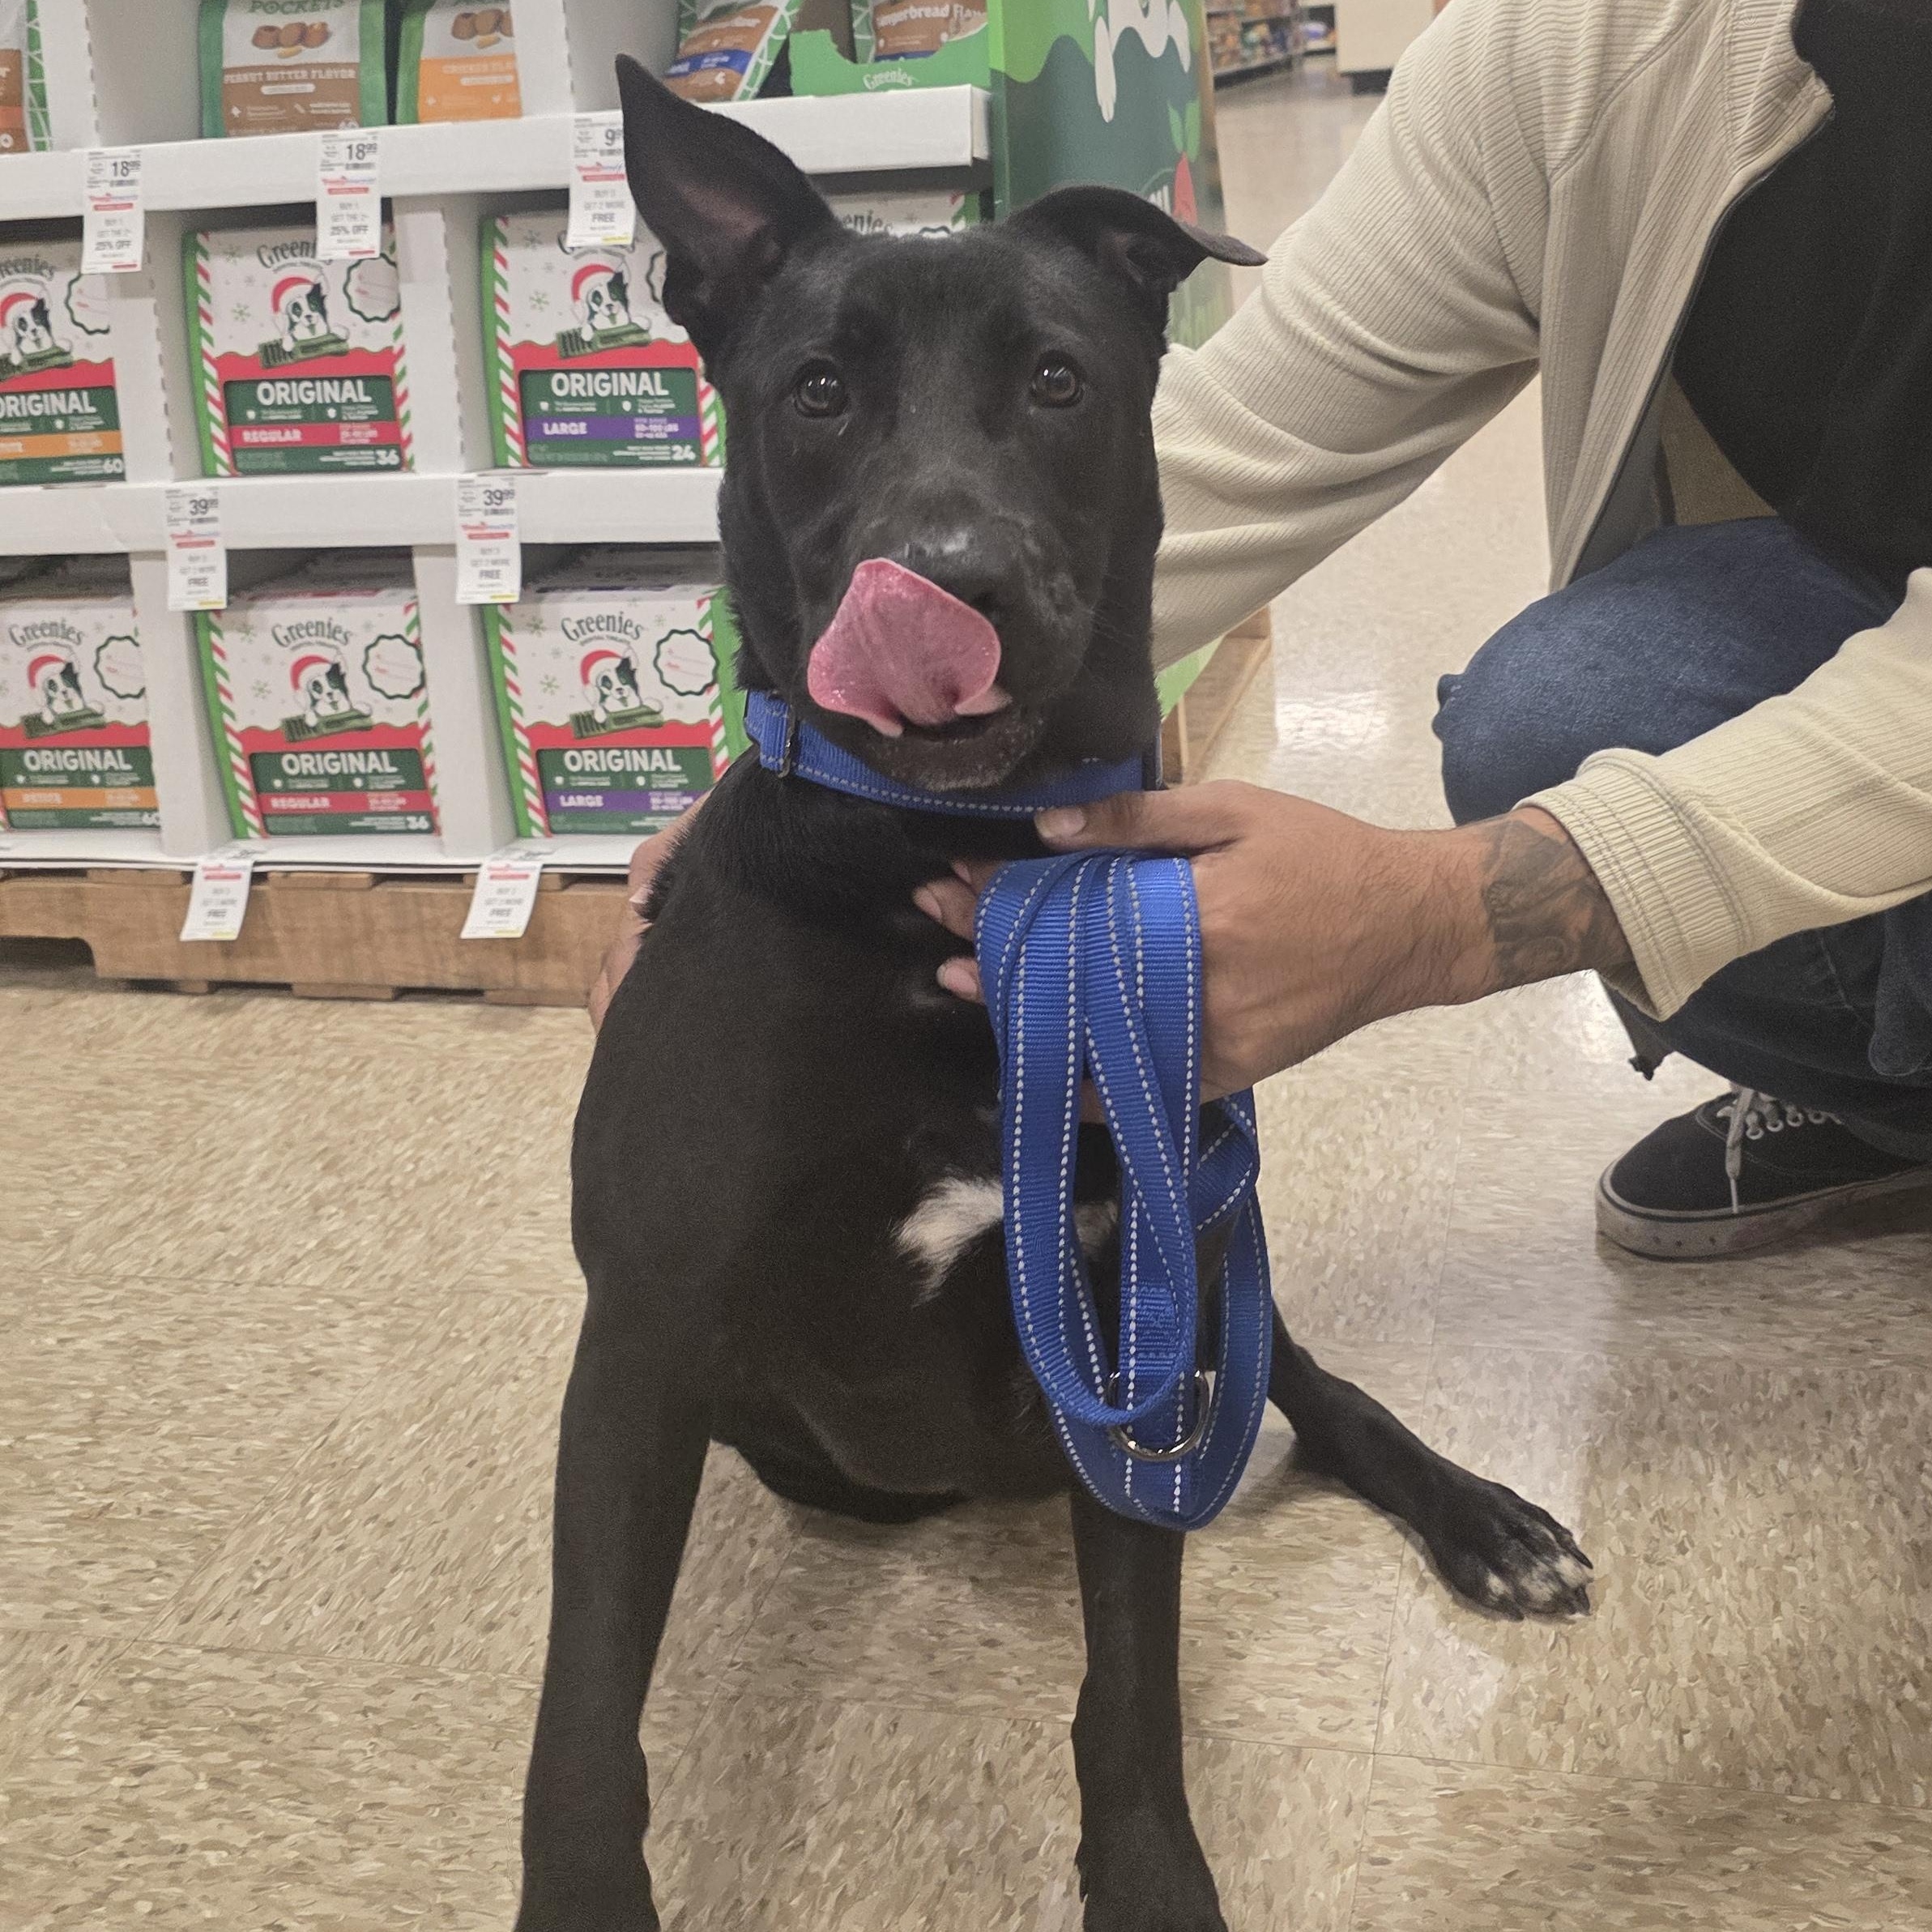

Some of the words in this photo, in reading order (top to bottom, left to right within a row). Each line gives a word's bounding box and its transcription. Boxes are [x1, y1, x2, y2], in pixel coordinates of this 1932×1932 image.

[863, 67, 913, 90] Greenies
[592, 213, 616, 223] FREE
[257, 240, 317, 268] Greeni
[0, 254, 56, 281] reenies
[257, 379, 372, 405] ORIGINAL
[551, 372, 669, 397] ORIGINAL
[543, 421, 587, 435] LARGE
[376, 450, 400, 466] 36
[480, 569, 501, 579] FREE
[8, 618, 83, 646] Greenies
[271, 616, 352, 648] Greenies
[561, 611, 644, 641] Greenies
[23, 749, 133, 771] ORIGINAL
[281, 751, 399, 775] ORIGINAL
[564, 749, 682, 772] ORIGINAL
[559, 795, 604, 808] LARGE
